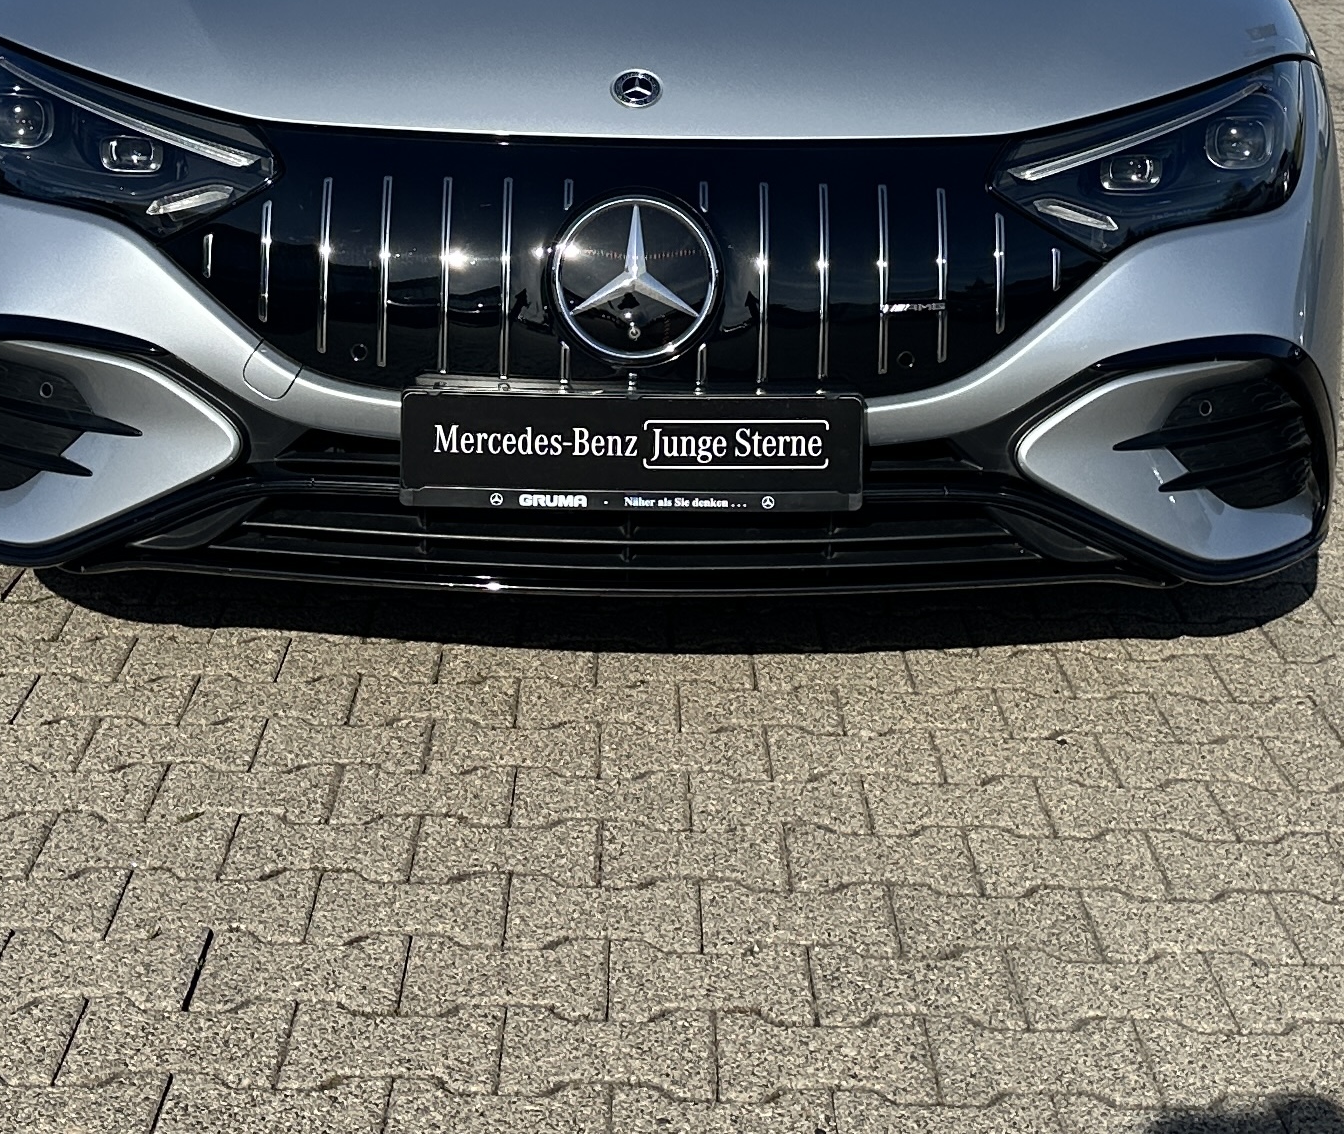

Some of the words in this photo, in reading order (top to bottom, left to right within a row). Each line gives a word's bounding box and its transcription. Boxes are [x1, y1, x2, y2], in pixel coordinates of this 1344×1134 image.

[433, 423, 638, 457] Mercedes-Benz
[650, 428, 727, 464] Junge
[734, 428, 823, 458] Sterne
[518, 494, 588, 508] GRUMA
[624, 496, 656, 507] Näher
[657, 497, 673, 507] als
[674, 497, 690, 507] Sie
[691, 497, 729, 508] denken
